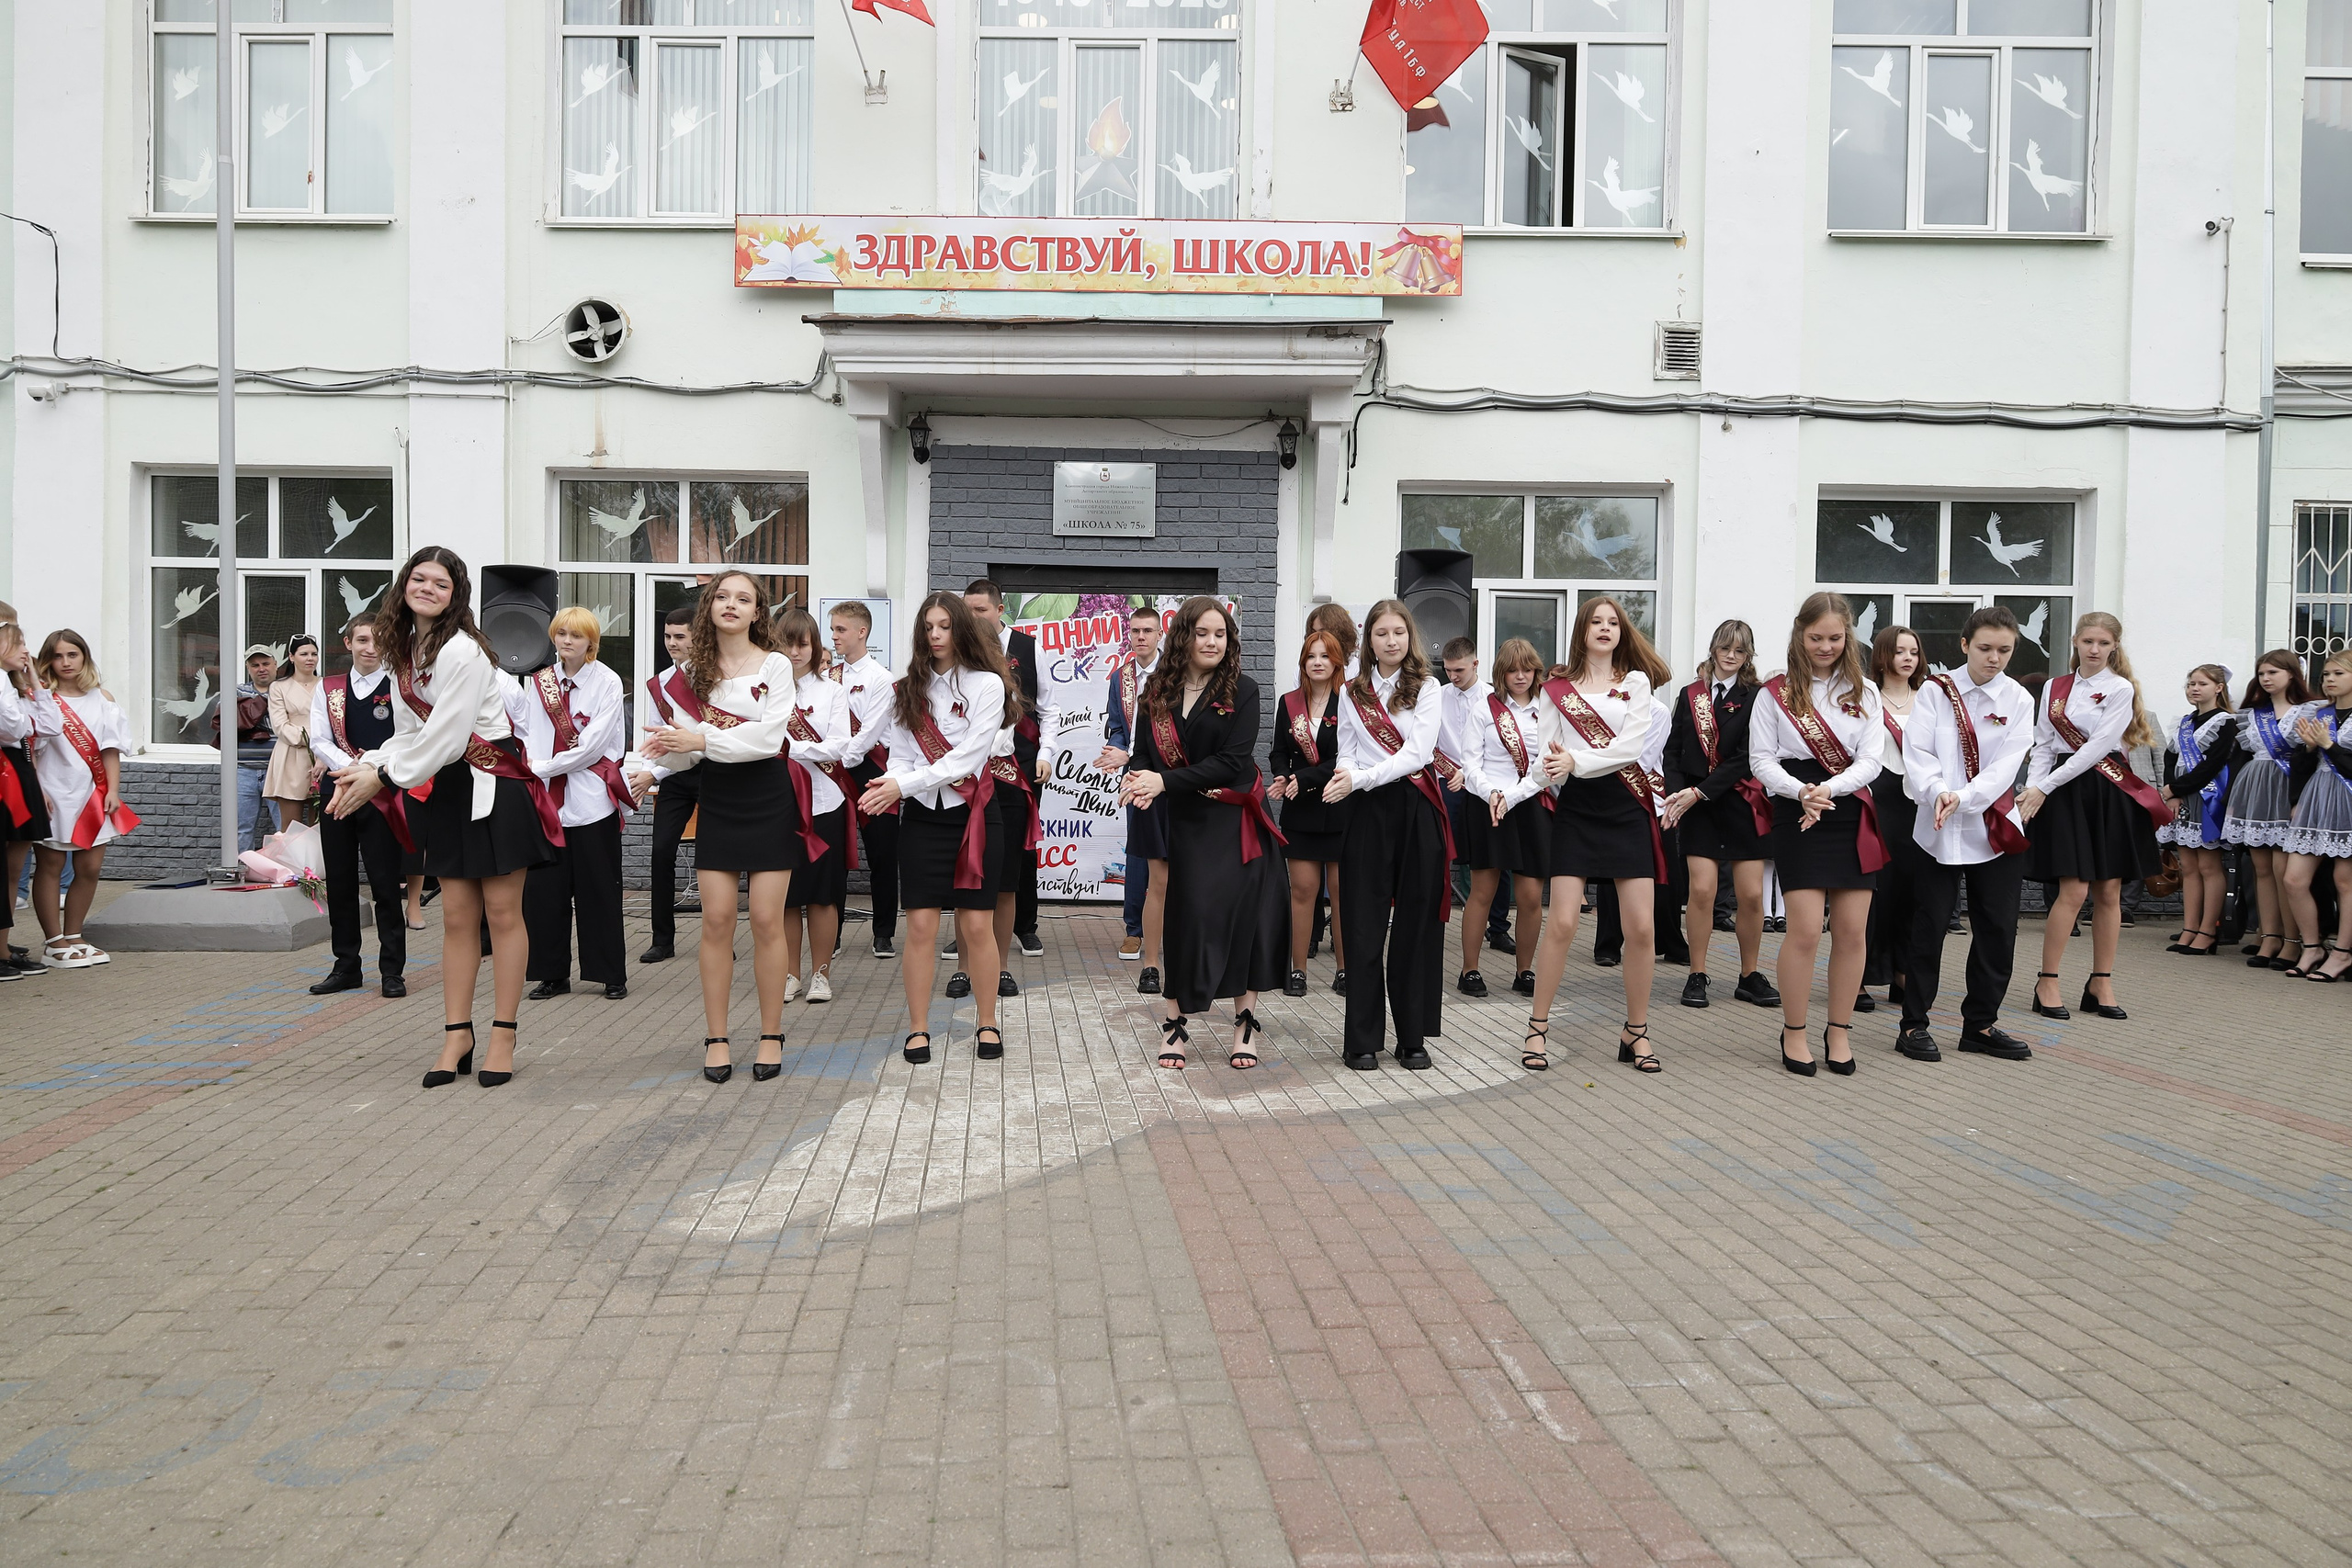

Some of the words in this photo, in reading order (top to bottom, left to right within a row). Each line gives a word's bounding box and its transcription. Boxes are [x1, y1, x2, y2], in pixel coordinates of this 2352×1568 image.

[854, 228, 1156, 281] ЗДРАВСТВУЙ,
[1172, 239, 1372, 276] ШКОЛА!
[1114, 521, 1128, 530] №
[1036, 868, 1100, 900] йствуй!
